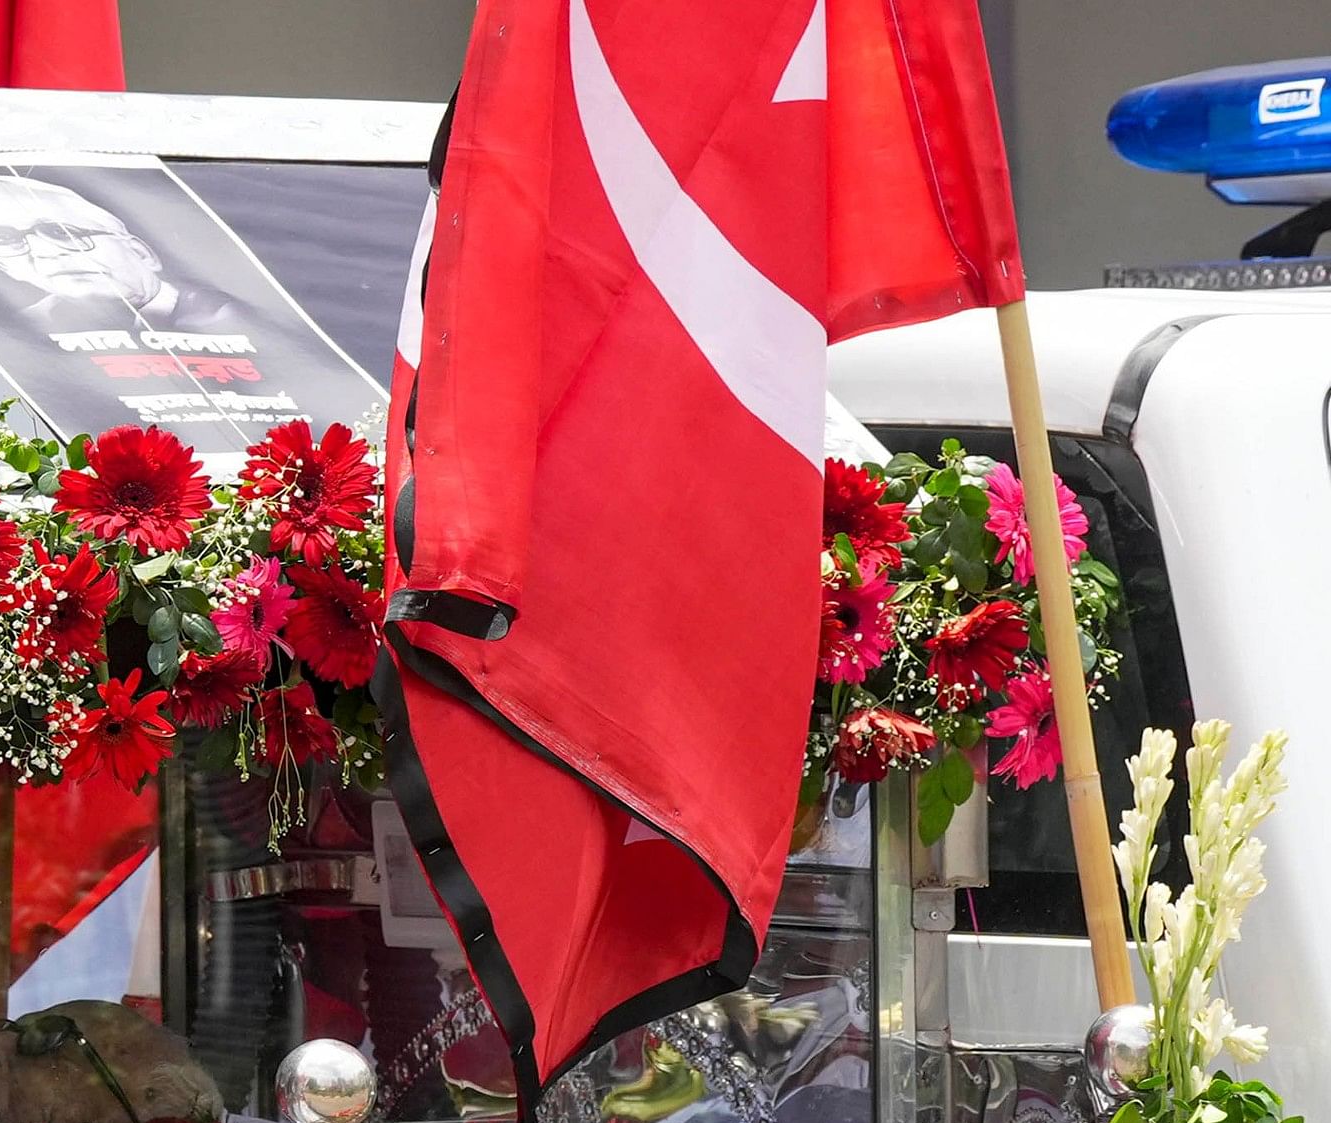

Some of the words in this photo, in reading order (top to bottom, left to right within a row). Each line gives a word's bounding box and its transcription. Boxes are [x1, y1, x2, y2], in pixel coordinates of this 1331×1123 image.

[49, 331, 139, 353] লাল
[141, 330, 257, 354] সেলাম
[90, 355, 263, 385] কমরেড
